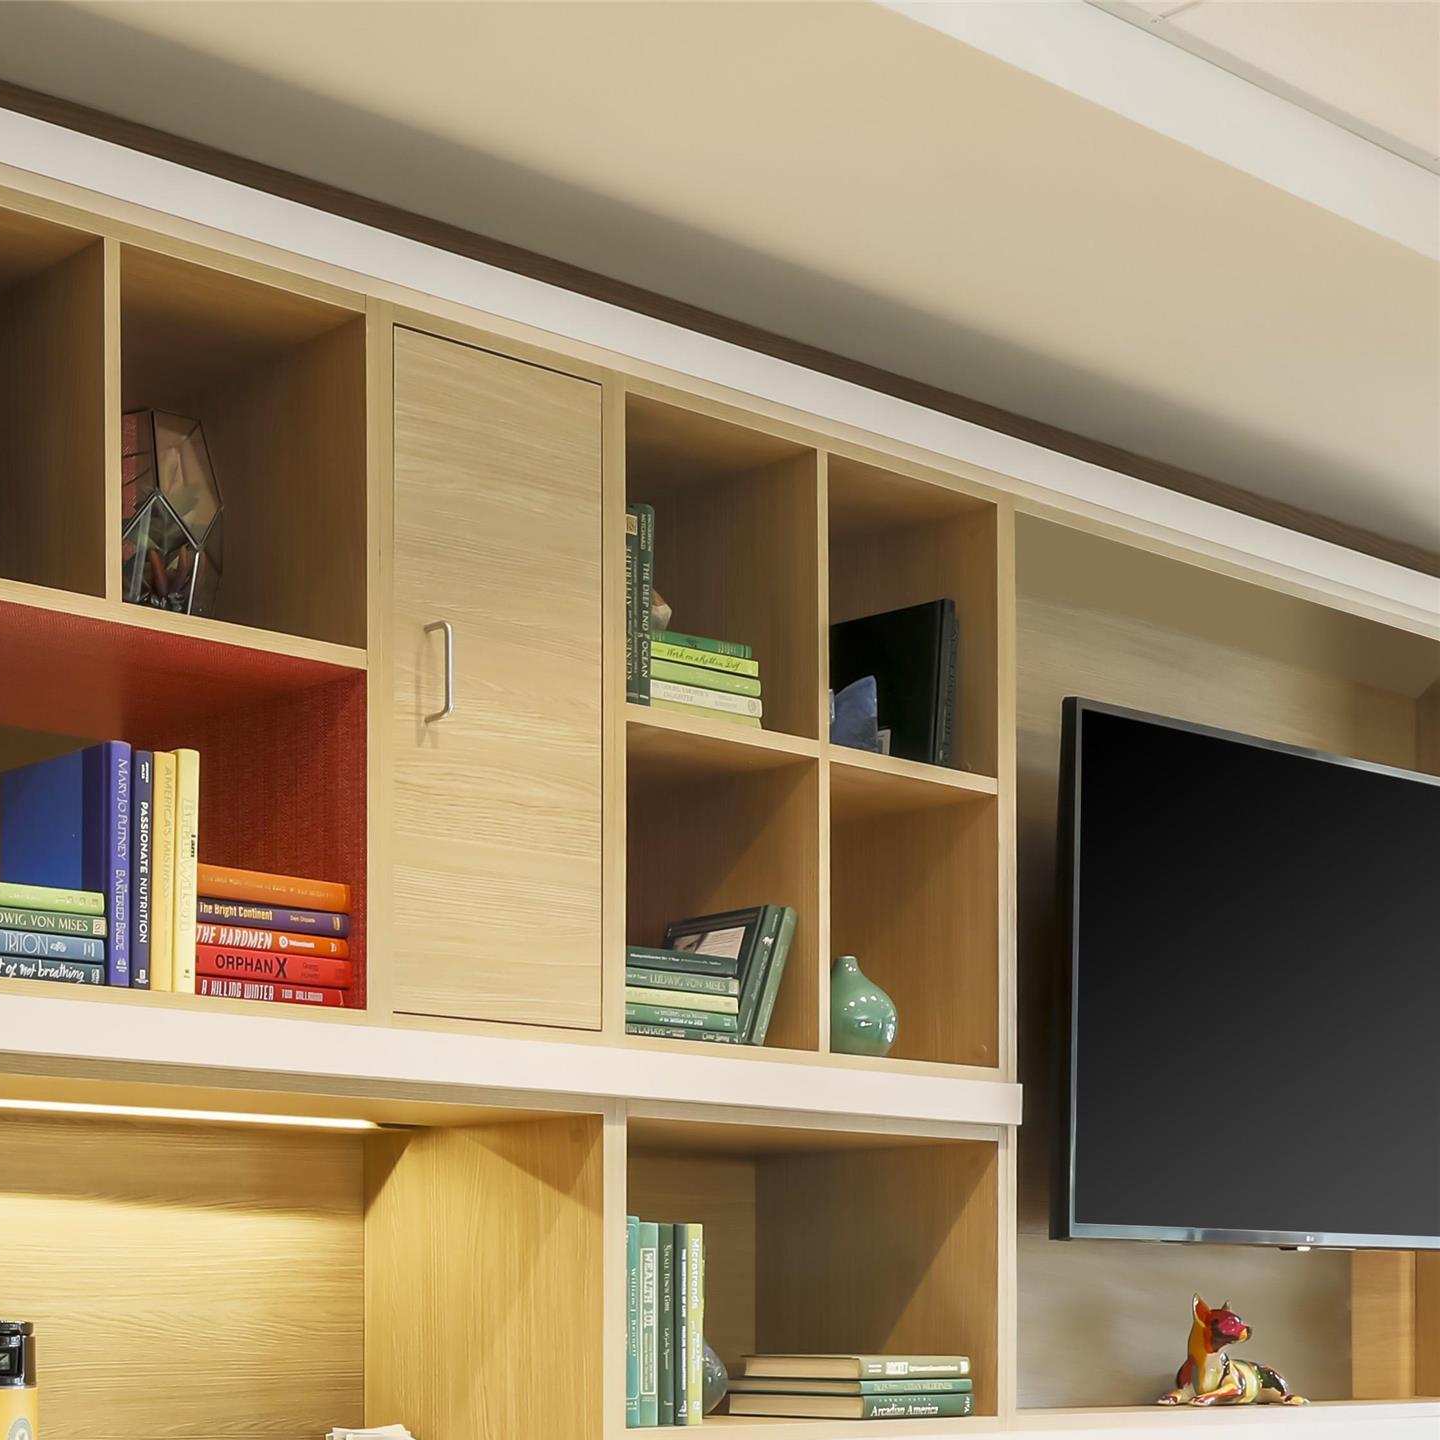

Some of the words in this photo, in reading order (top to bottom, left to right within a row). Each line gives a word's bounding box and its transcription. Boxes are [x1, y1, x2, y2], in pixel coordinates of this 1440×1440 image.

[642, 562, 651, 581] THE
[640, 641, 649, 678] OCEAN
[117, 758, 128, 796] MARY
[117, 797, 127, 813] JO
[116, 814, 127, 861] PUTNEY
[139, 801, 149, 874] PASSIONATE
[30, 914, 56, 928] VON
[58, 918, 89, 932] MISES
[138, 877, 149, 944] NUTRITION
[199, 901, 213, 914] The
[214, 903, 238, 919] Bright
[238, 904, 273, 921] Continent
[196, 924, 216, 944] THE
[219, 927, 273, 950] HARDMEN
[37, 959, 85, 983] breathing
[215, 954, 273, 974] ORPHAN
[275, 957, 289, 979] X
[201, 979, 208, 995] A
[643, 1252, 654, 1304] WEALTH
[690, 1237, 701, 1310] Microtrends
[643, 1308, 654, 1329] 101
[870, 1403, 905, 1416] Arcadian
[906, 1402, 939, 1416] America
